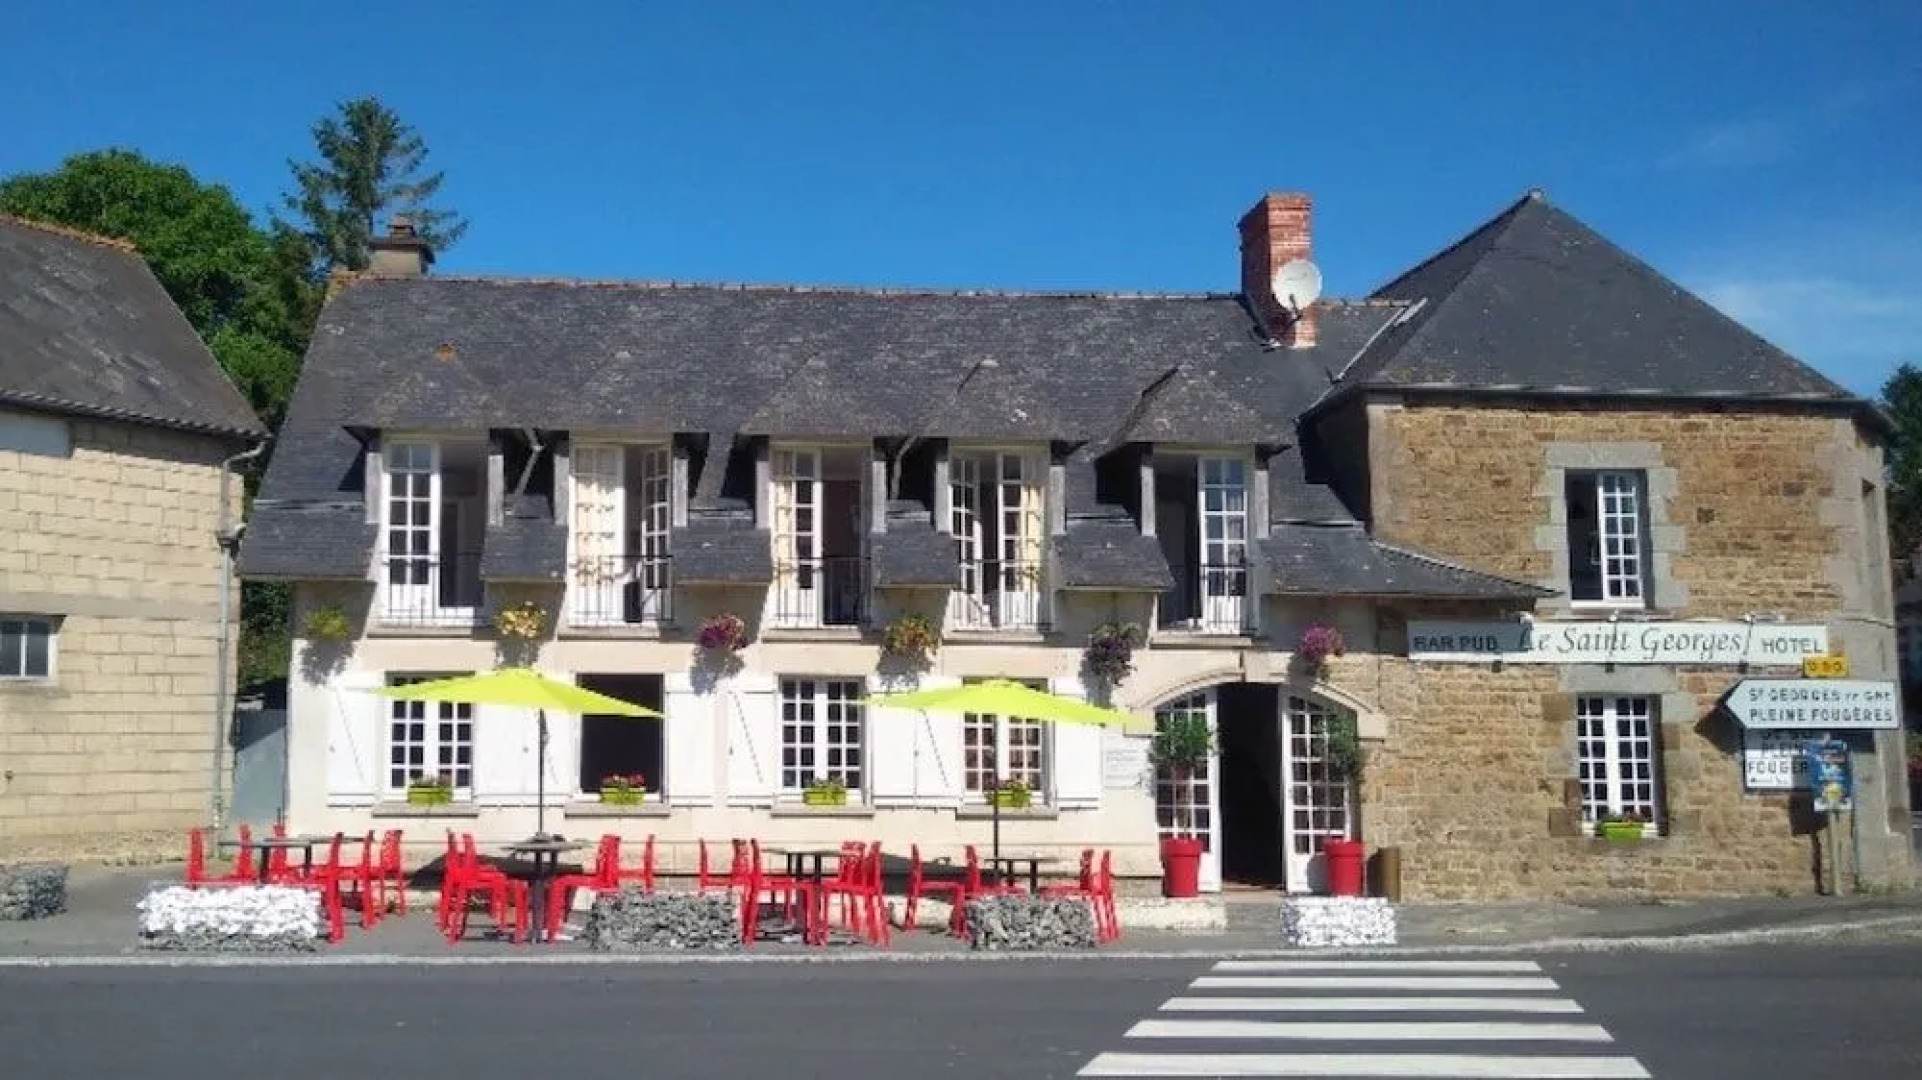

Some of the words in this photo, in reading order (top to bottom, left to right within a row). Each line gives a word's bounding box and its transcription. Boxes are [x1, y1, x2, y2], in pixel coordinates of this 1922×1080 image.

[1557, 626, 1631, 652] Saint
[1640, 626, 1741, 659] Georges
[1769, 688, 1840, 701] GEORGES
[1750, 708, 1806, 721] PLEINE
